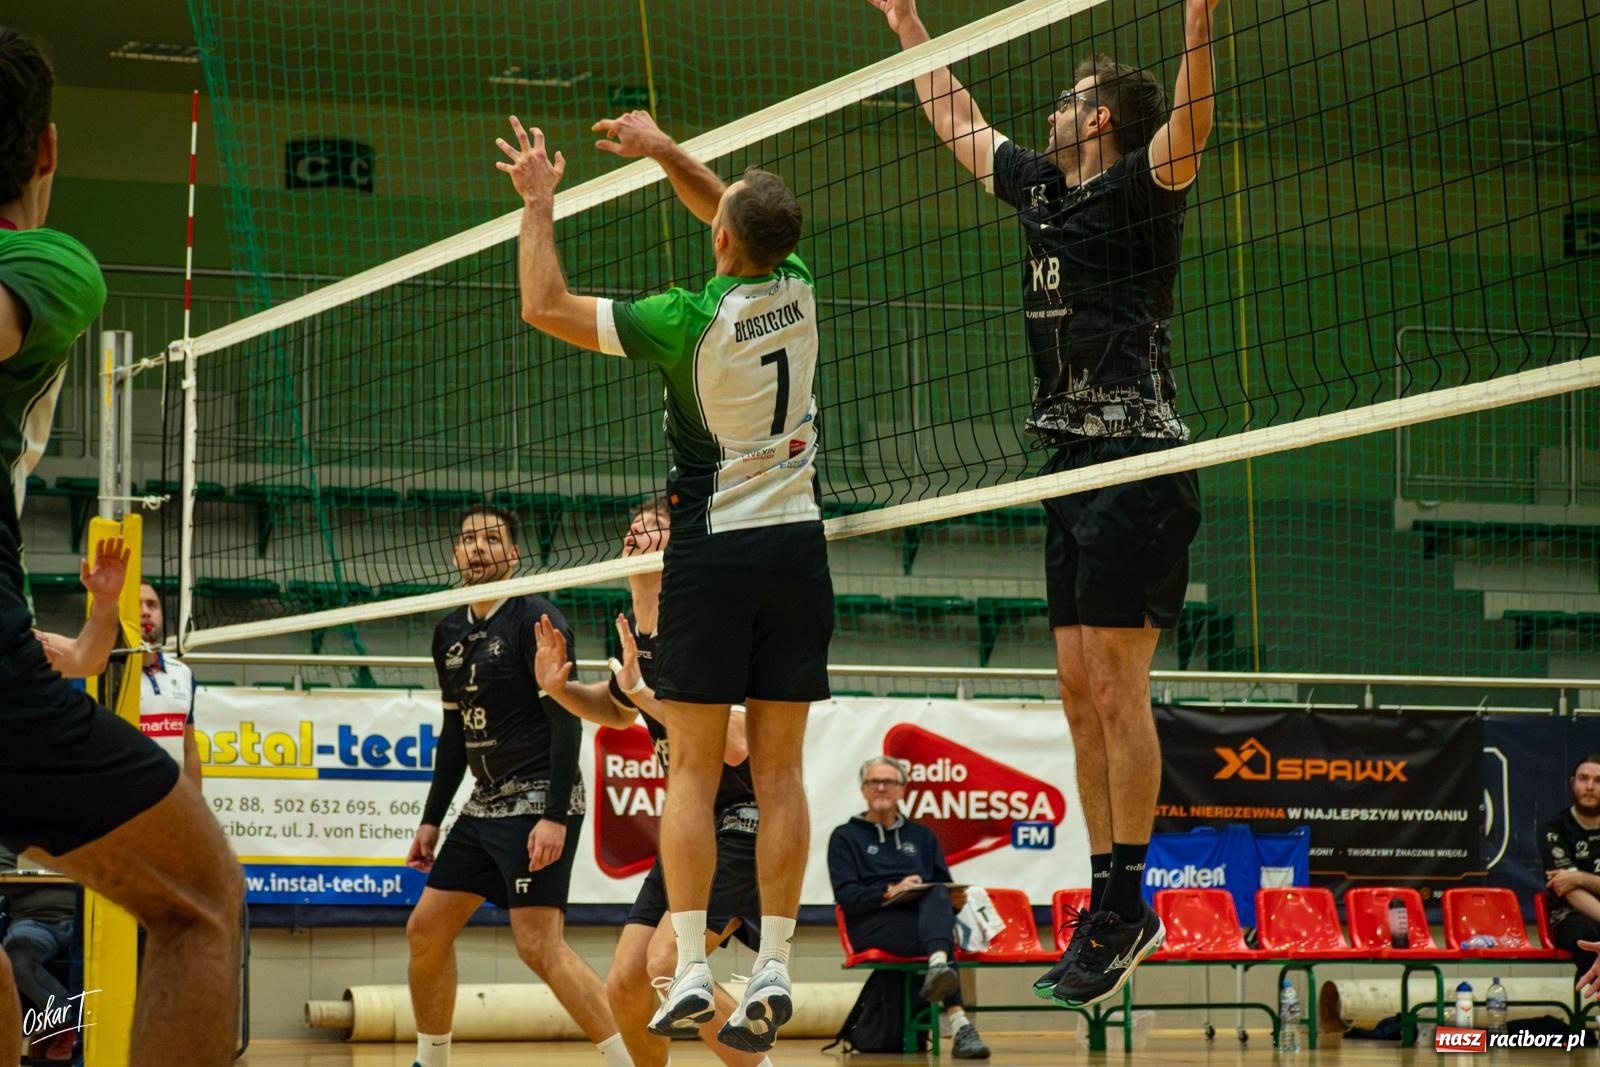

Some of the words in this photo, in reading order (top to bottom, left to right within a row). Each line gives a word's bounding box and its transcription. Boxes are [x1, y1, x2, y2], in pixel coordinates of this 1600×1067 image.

[734, 299, 805, 343] BŁASZCZOK
[761, 347, 790, 436] 7
[1276, 757, 1408, 782] SPAWX
[274, 799, 304, 814] 502
[310, 799, 341, 814] 632
[390, 801, 421, 815] 606
[1190, 805, 1286, 819] NIERDZEWNA
[1287, 807, 1302, 819] W
[1304, 808, 1400, 821] NAJLEPSZYM
[1401, 809, 1469, 822] WYDANIU
[323, 826, 354, 839] von
[1017, 826, 1049, 846] FM
[1145, 864, 1226, 888] molten
